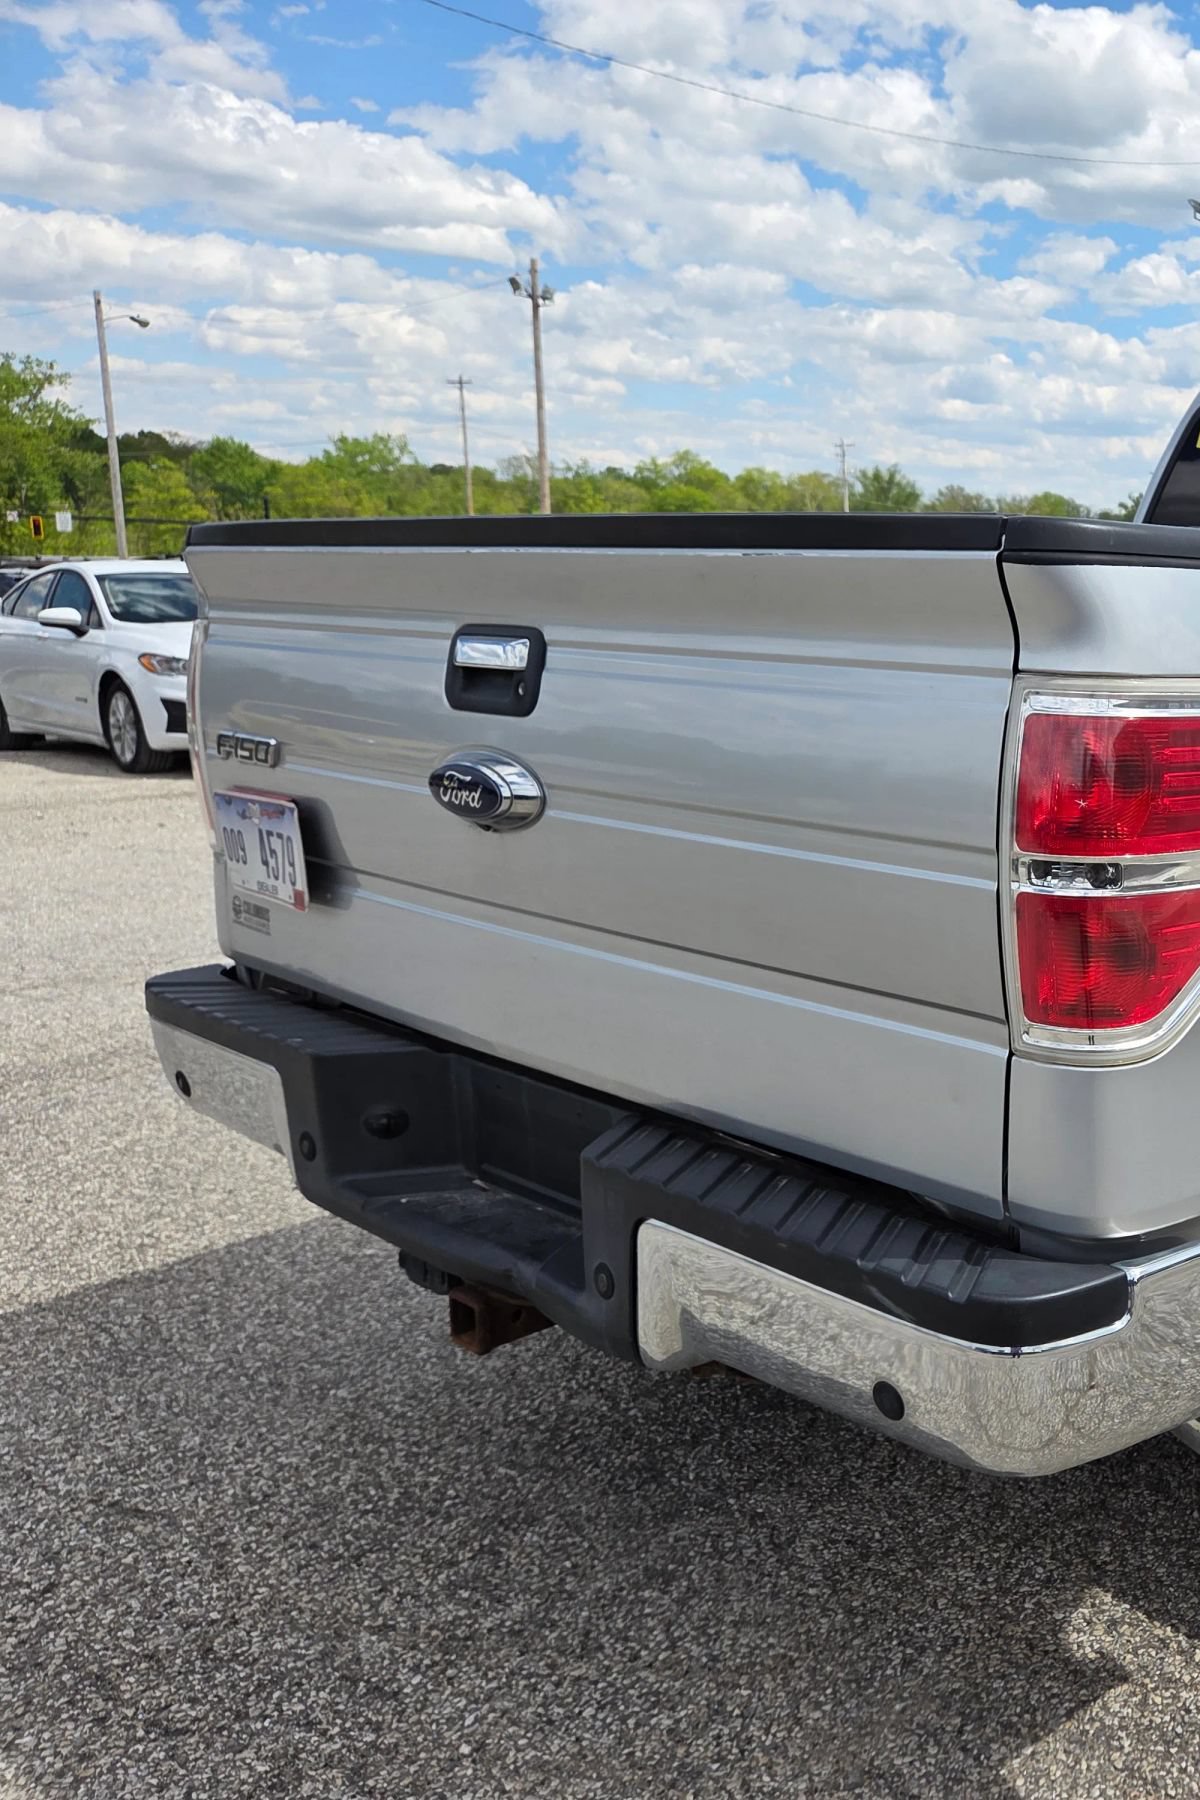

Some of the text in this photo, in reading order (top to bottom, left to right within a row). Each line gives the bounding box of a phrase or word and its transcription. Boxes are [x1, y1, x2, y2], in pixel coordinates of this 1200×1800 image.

[217, 732, 270, 764] F-150
[440, 770, 483, 808] Ford
[222, 826, 297, 887] 009 4579
